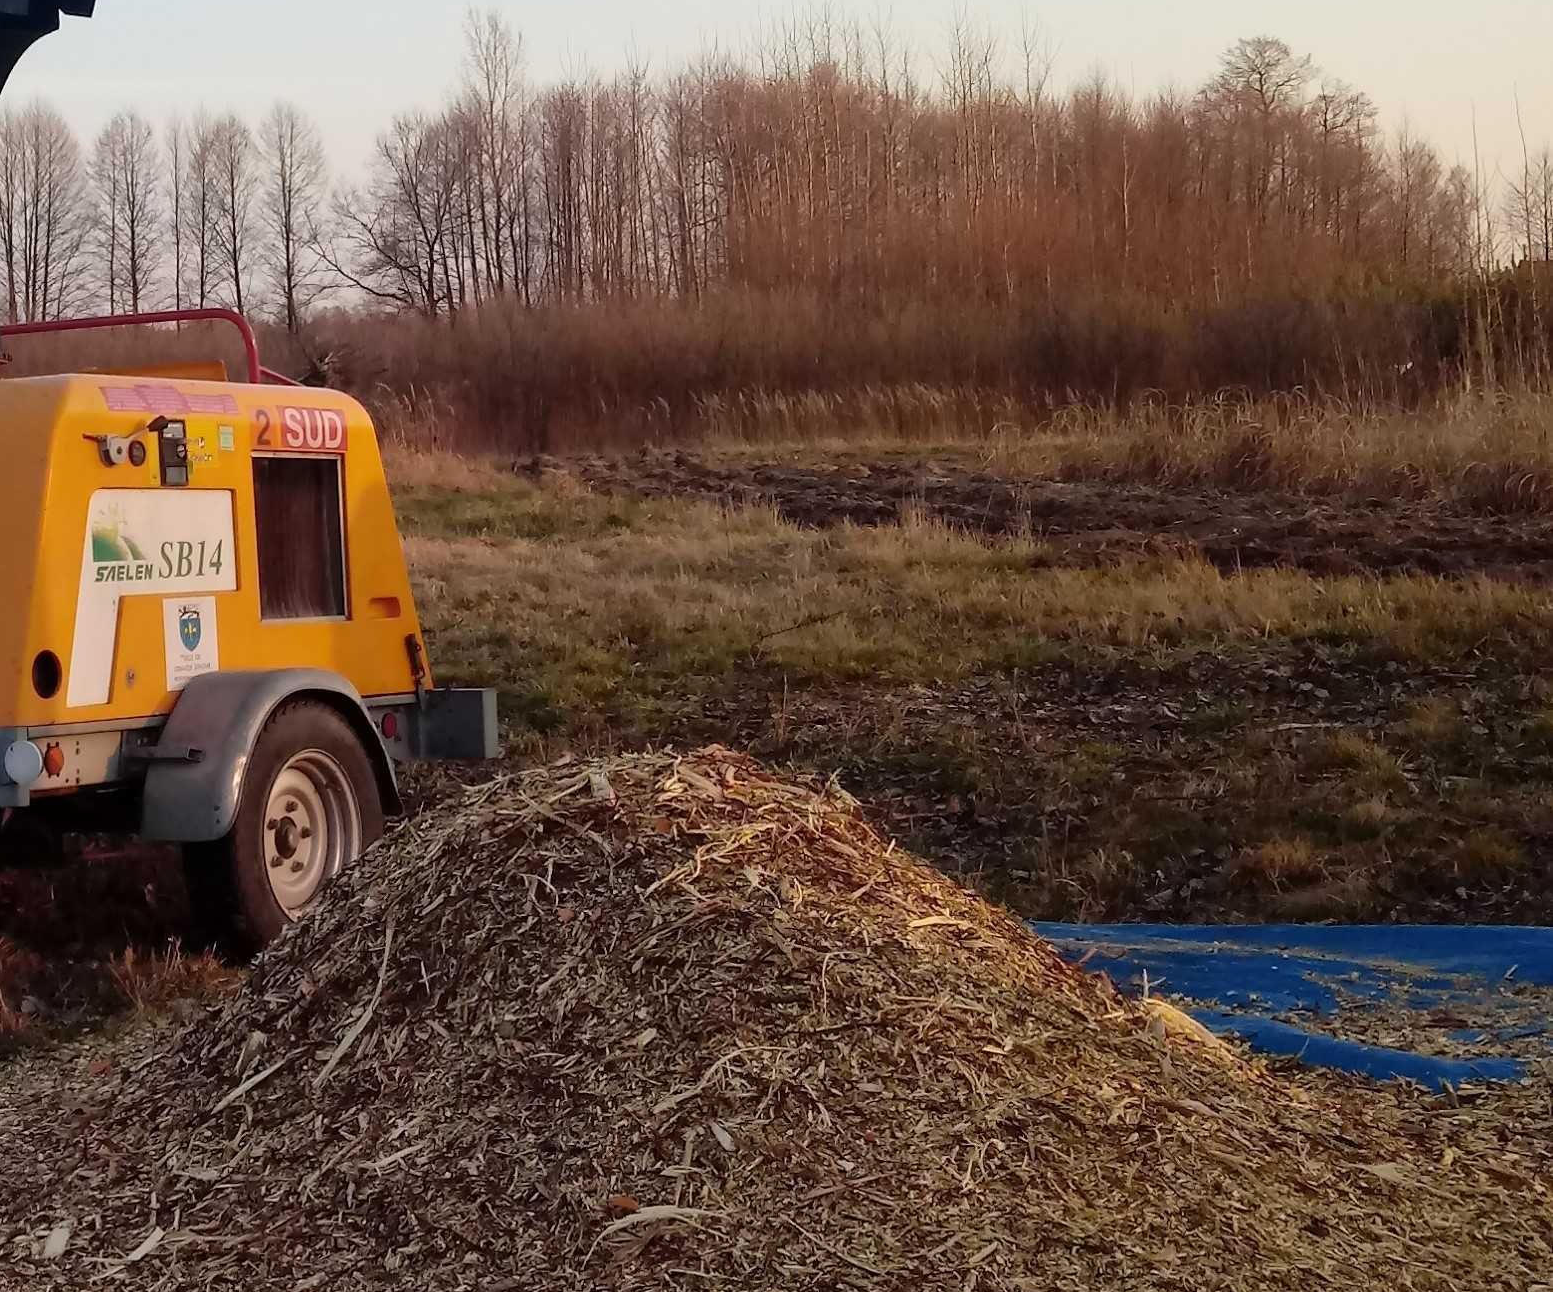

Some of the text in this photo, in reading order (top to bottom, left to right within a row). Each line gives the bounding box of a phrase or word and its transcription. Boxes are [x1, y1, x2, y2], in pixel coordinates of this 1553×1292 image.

[257, 407, 343, 449] 2 SUD
[94, 563, 154, 583] SAELEN
[158, 538, 223, 581] SB14
